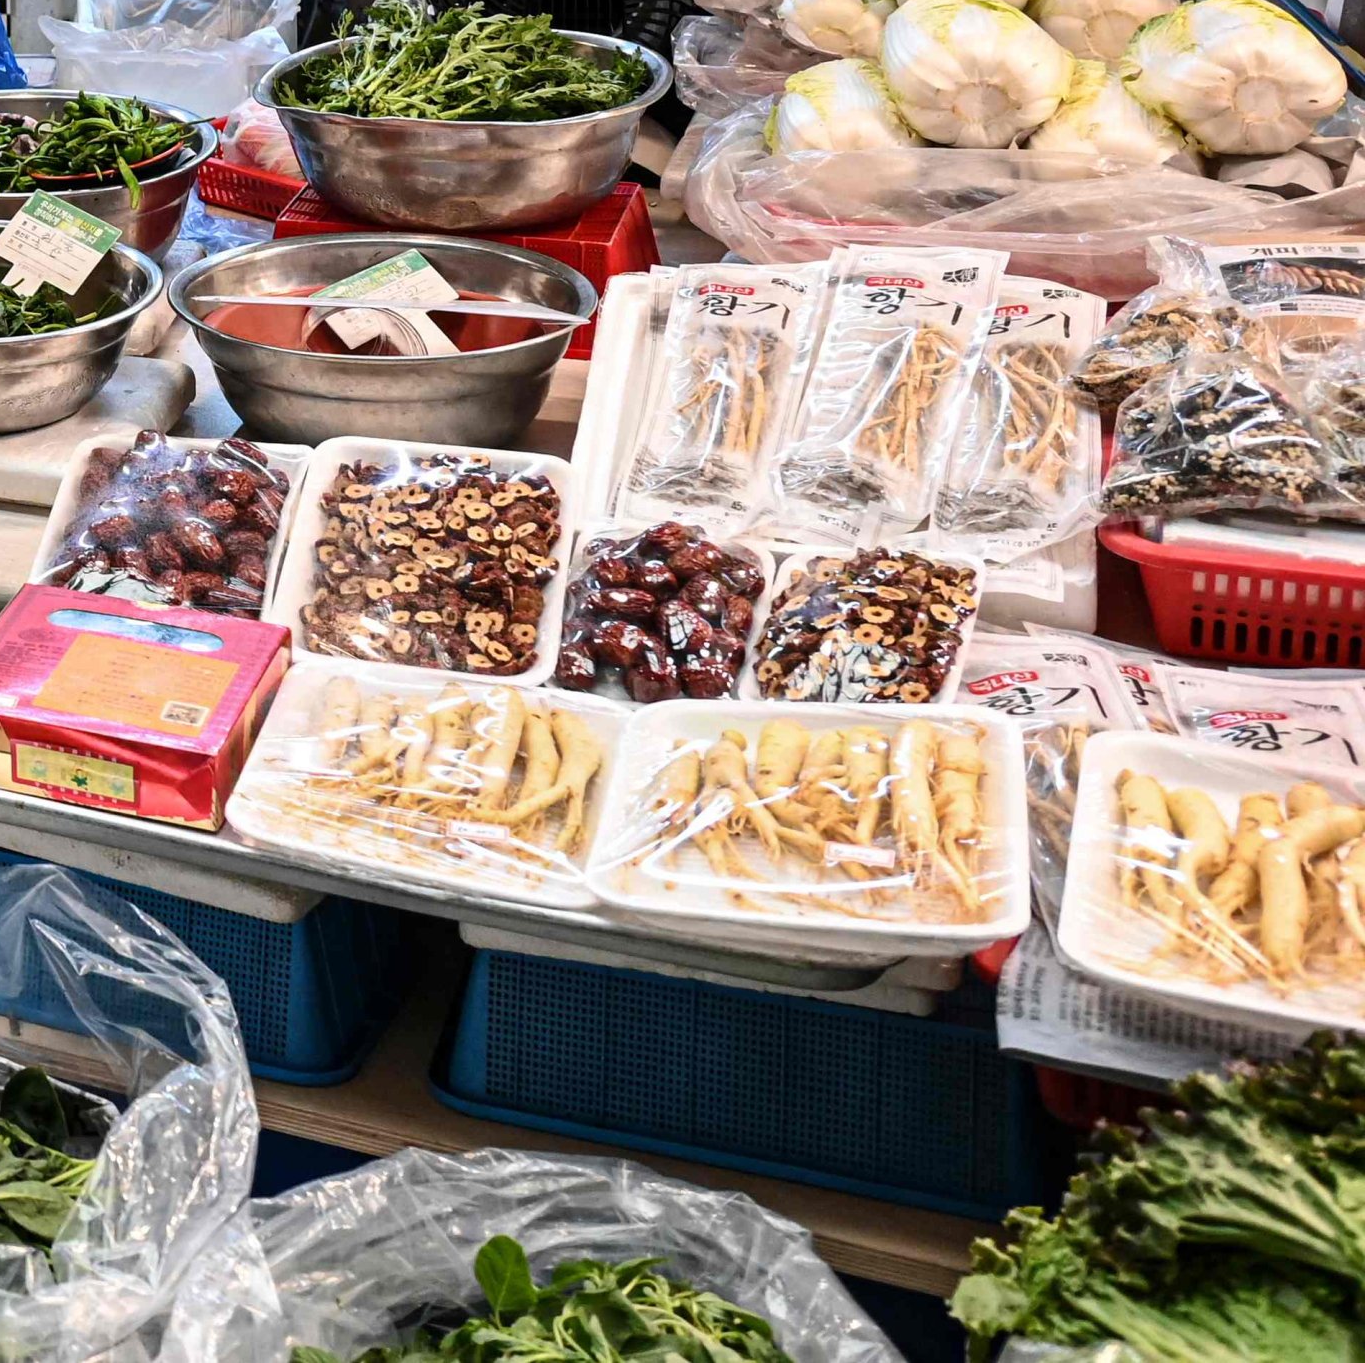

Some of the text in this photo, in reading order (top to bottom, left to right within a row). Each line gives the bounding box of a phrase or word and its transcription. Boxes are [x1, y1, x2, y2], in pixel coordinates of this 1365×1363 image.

[1249, 246, 1299, 256] 계피
[868, 277, 922, 289] 국내산
[696, 294, 791, 330] 황기
[862, 287, 964, 326] 황기
[971, 671, 1039, 694] 국내산
[977, 685, 1109, 720] 황기
[1221, 721, 1360, 767] 황기
